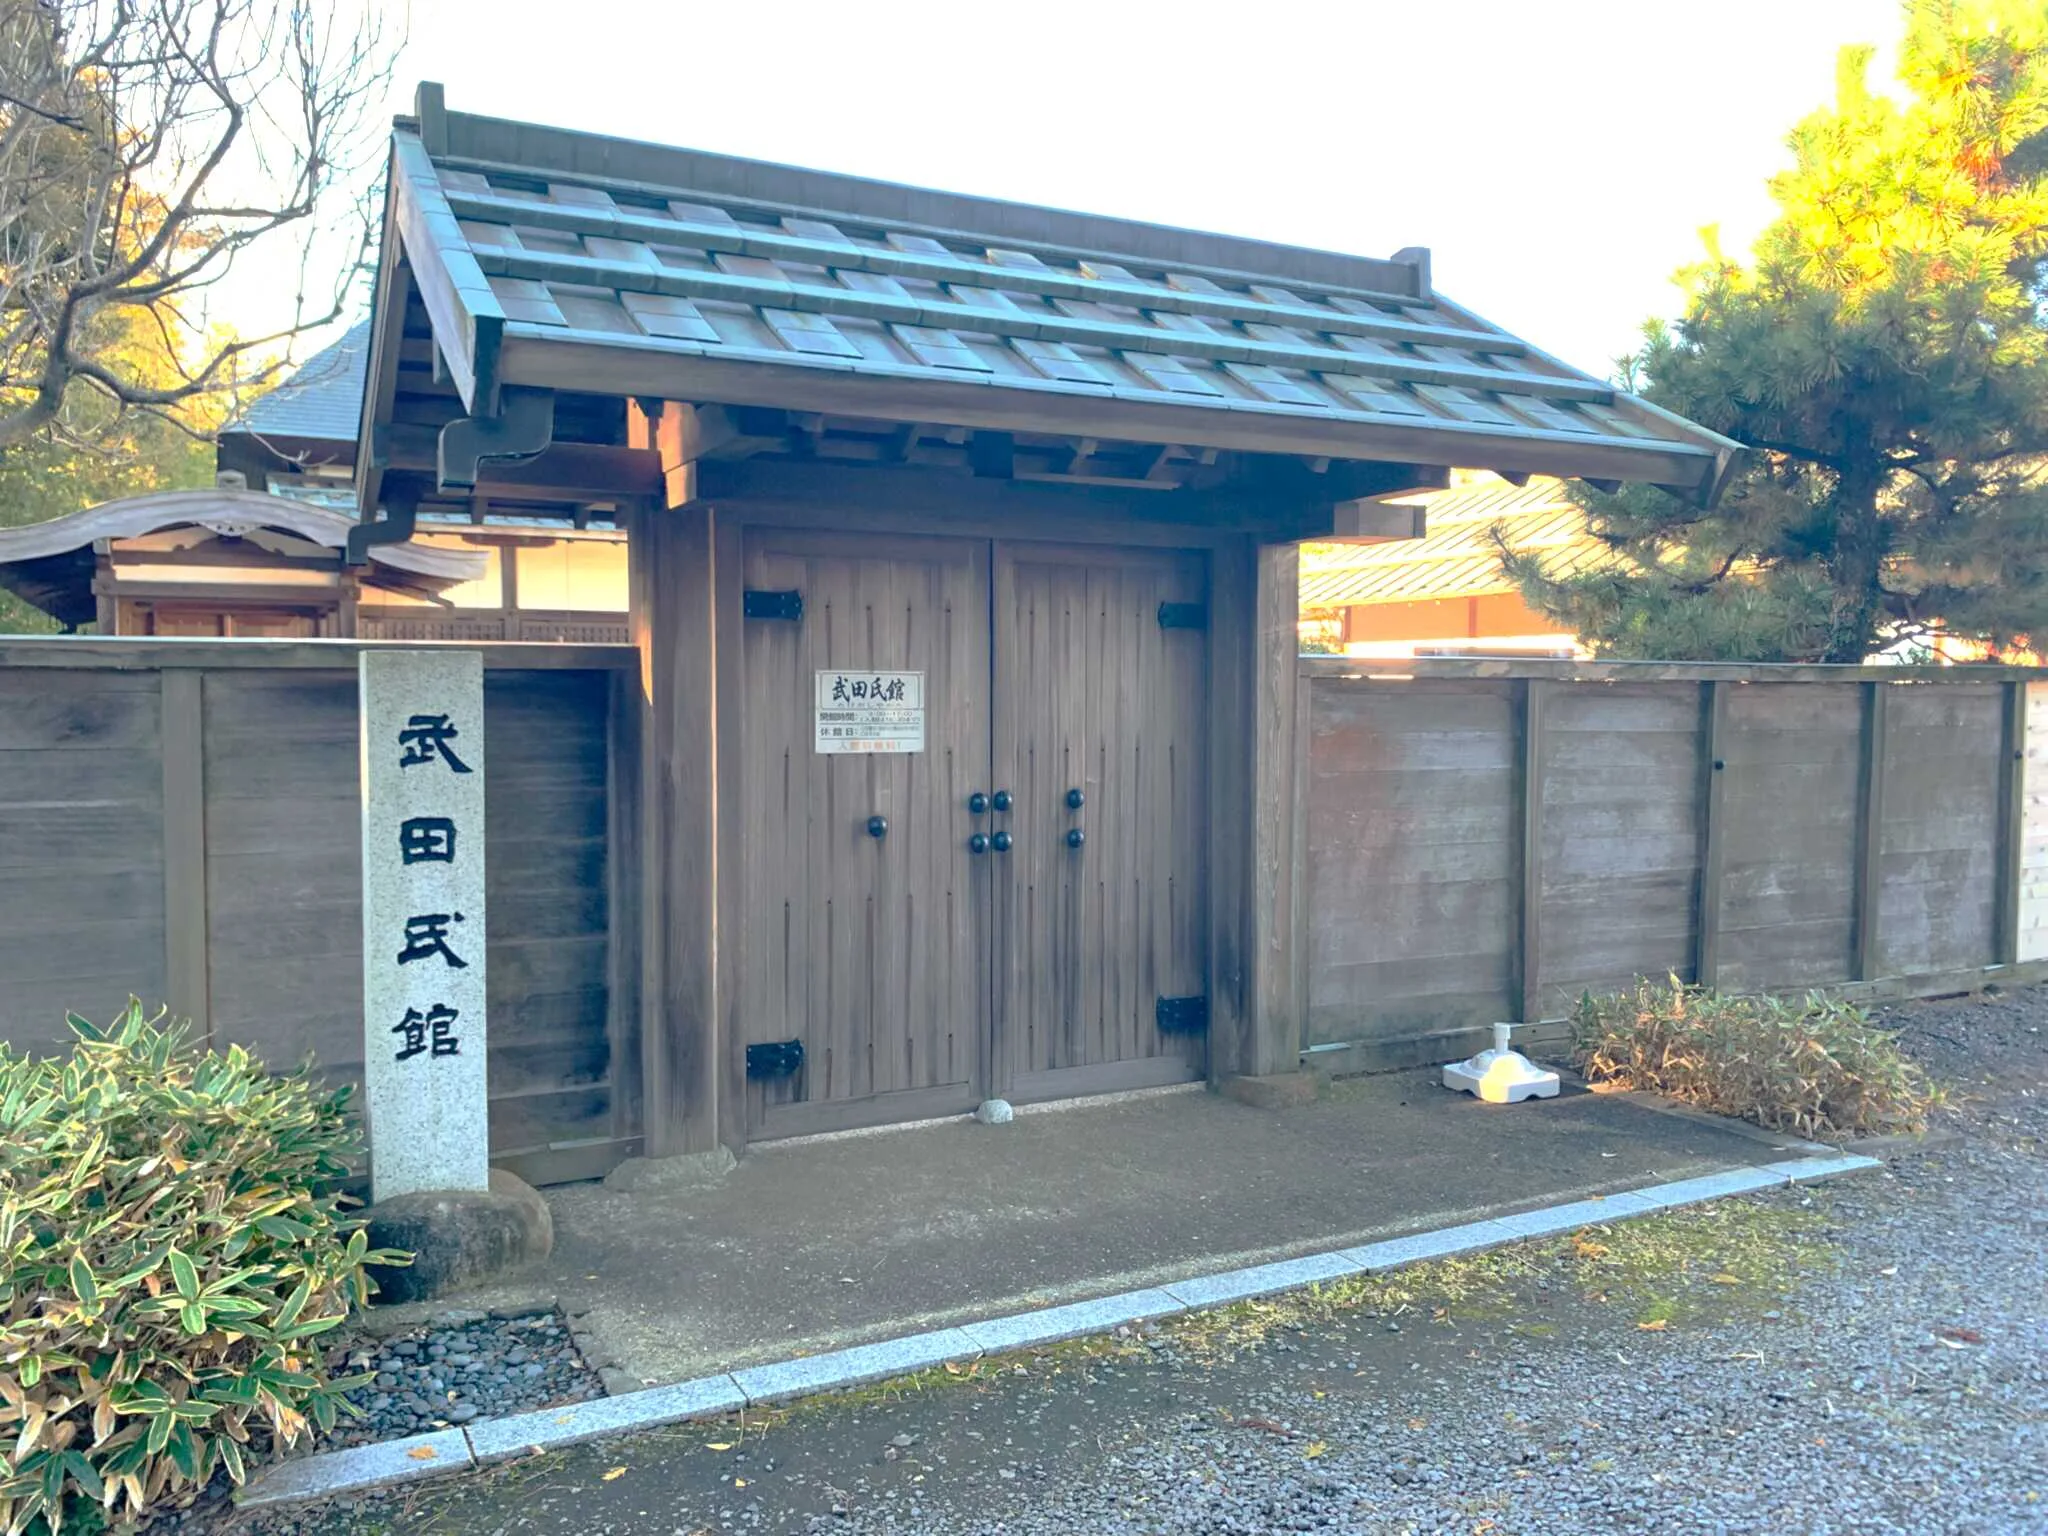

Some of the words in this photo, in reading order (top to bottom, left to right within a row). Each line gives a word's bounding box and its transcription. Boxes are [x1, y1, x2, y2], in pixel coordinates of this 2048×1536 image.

[832, 676, 905, 703] 武田氏館
[391, 713, 474, 1060] 武田氏館
